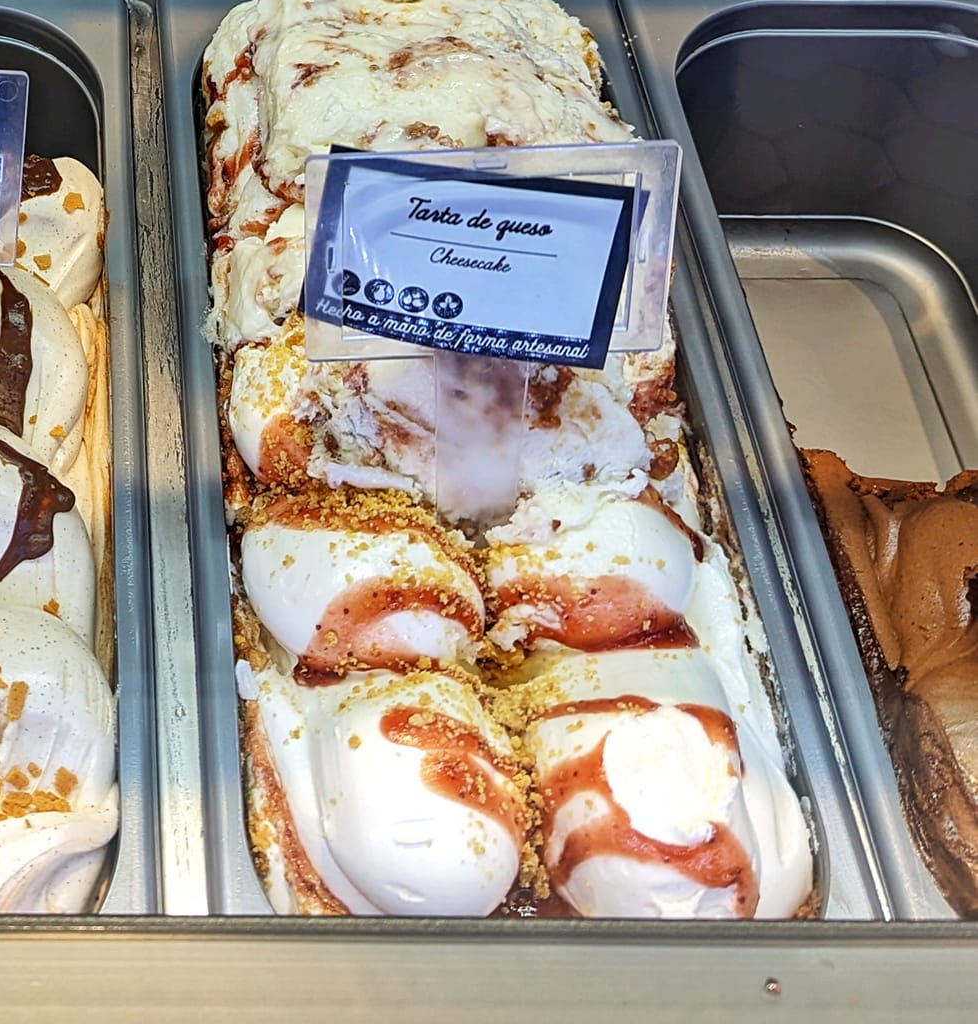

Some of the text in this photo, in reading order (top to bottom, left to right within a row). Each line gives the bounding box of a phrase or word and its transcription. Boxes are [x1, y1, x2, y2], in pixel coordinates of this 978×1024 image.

[408, 197, 553, 241] Tarta de queso
[430, 247, 511, 272] Cheesecake
[316, 299, 589, 359] Hecho a mano de forma artesanal
